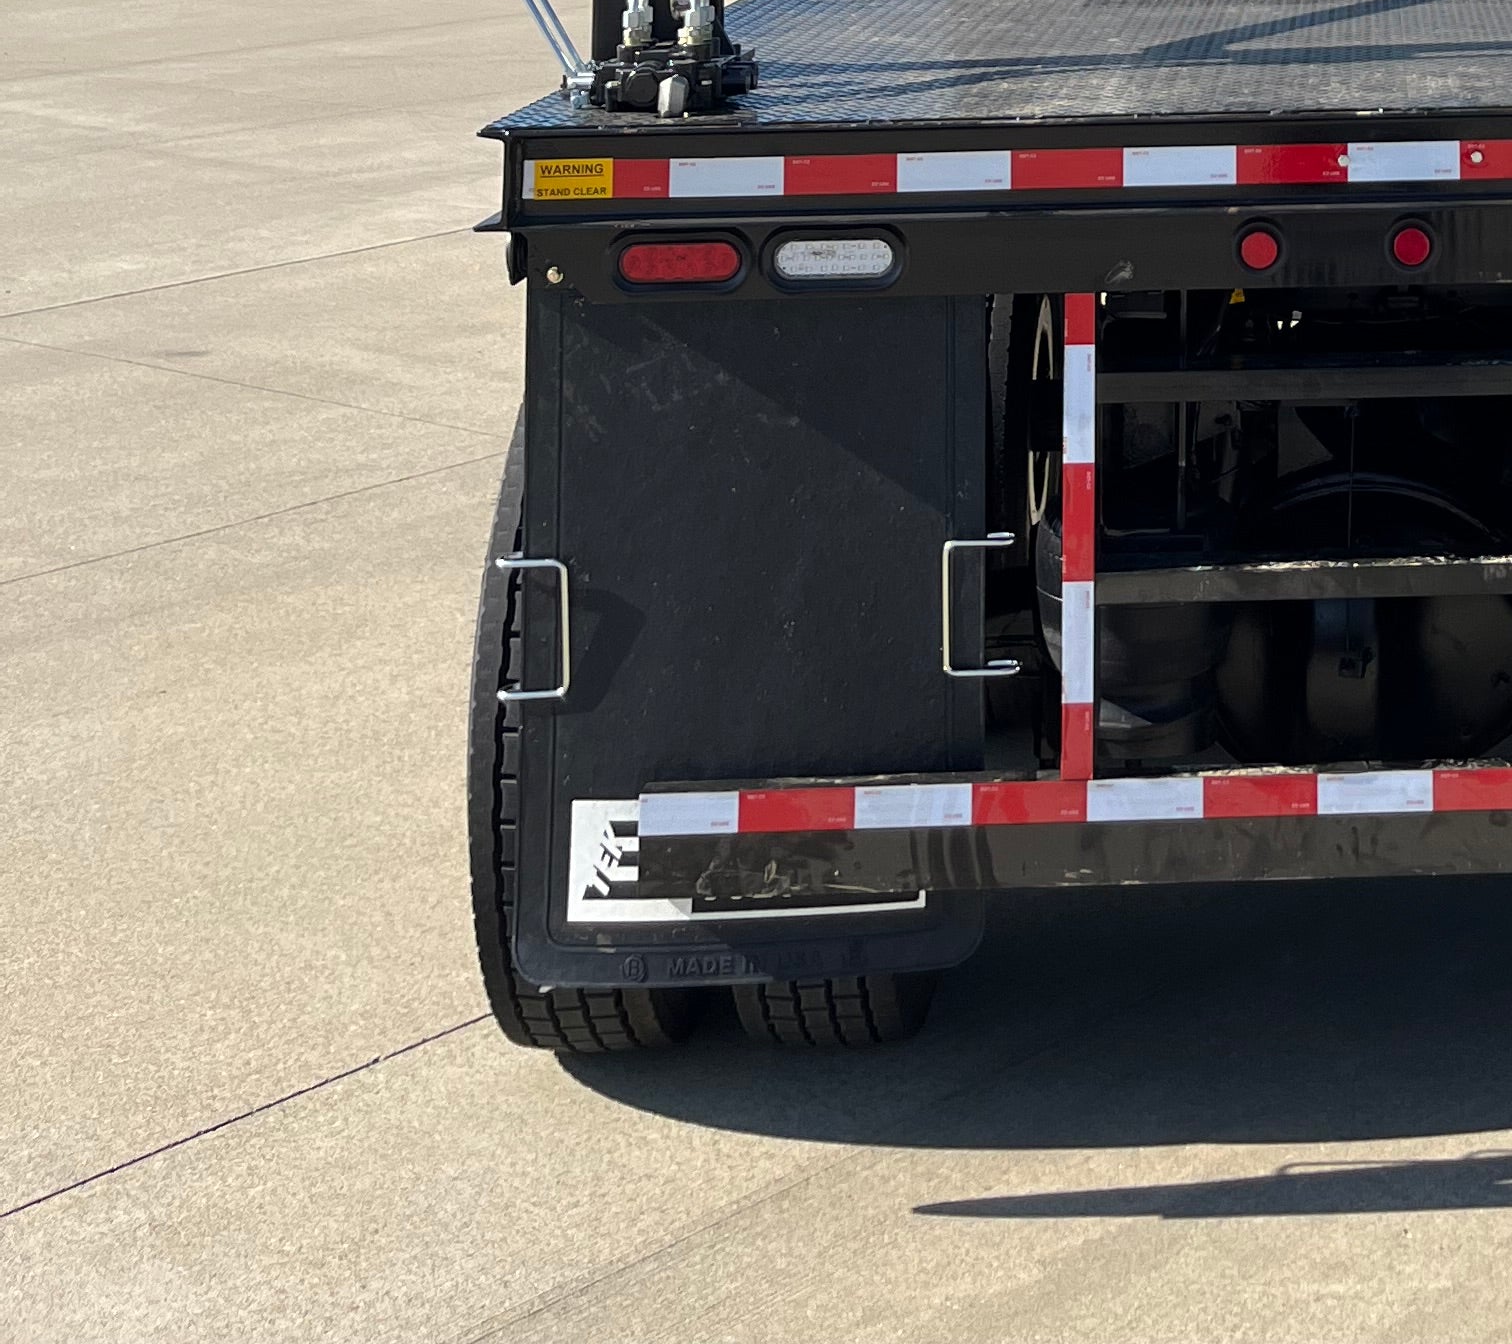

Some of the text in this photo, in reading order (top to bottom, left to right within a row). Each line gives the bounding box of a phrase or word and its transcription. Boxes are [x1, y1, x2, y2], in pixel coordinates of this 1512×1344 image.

[540, 164, 604, 176] WARNING
[536, 187, 607, 197] STAND CLEAR
[667, 956, 733, 977] MADE
